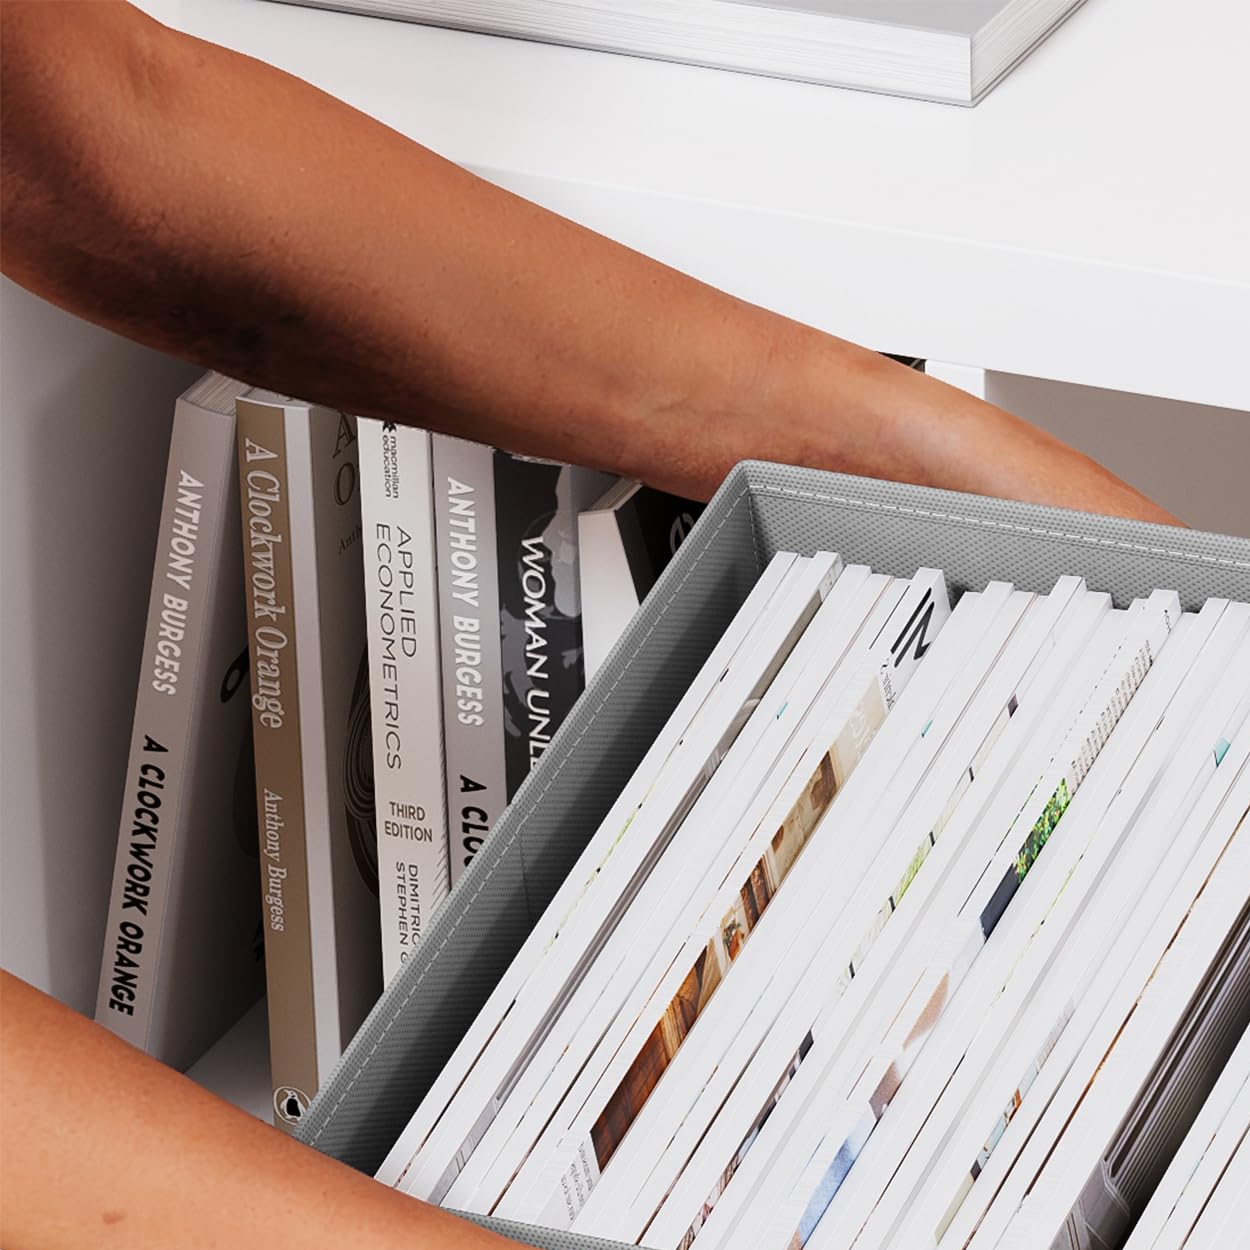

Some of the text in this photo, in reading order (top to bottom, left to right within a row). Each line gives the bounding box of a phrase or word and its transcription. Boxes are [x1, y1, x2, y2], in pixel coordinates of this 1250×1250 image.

[382, 434, 392, 498] education
[390, 435, 400, 499] macmillan
[152, 469, 204, 696] ANTHONY BURGESS
[245, 438, 288, 729] A Clockwork Orange
[376, 522, 401, 769] ECONOMETRICS
[397, 525, 417, 658] APPLIED
[447, 477, 484, 727] ANTHONY BURGESS
[521, 536, 548, 679] WOMAN
[109, 734, 168, 1016] A CLOCKWORK ORANGE
[263, 788, 287, 932] Anthony Burgess
[384, 822, 433, 843] EDITION
[389, 801, 426, 822] THIRD
[460, 774, 489, 867] A CLO
[396, 862, 408, 946] STEPHEN
